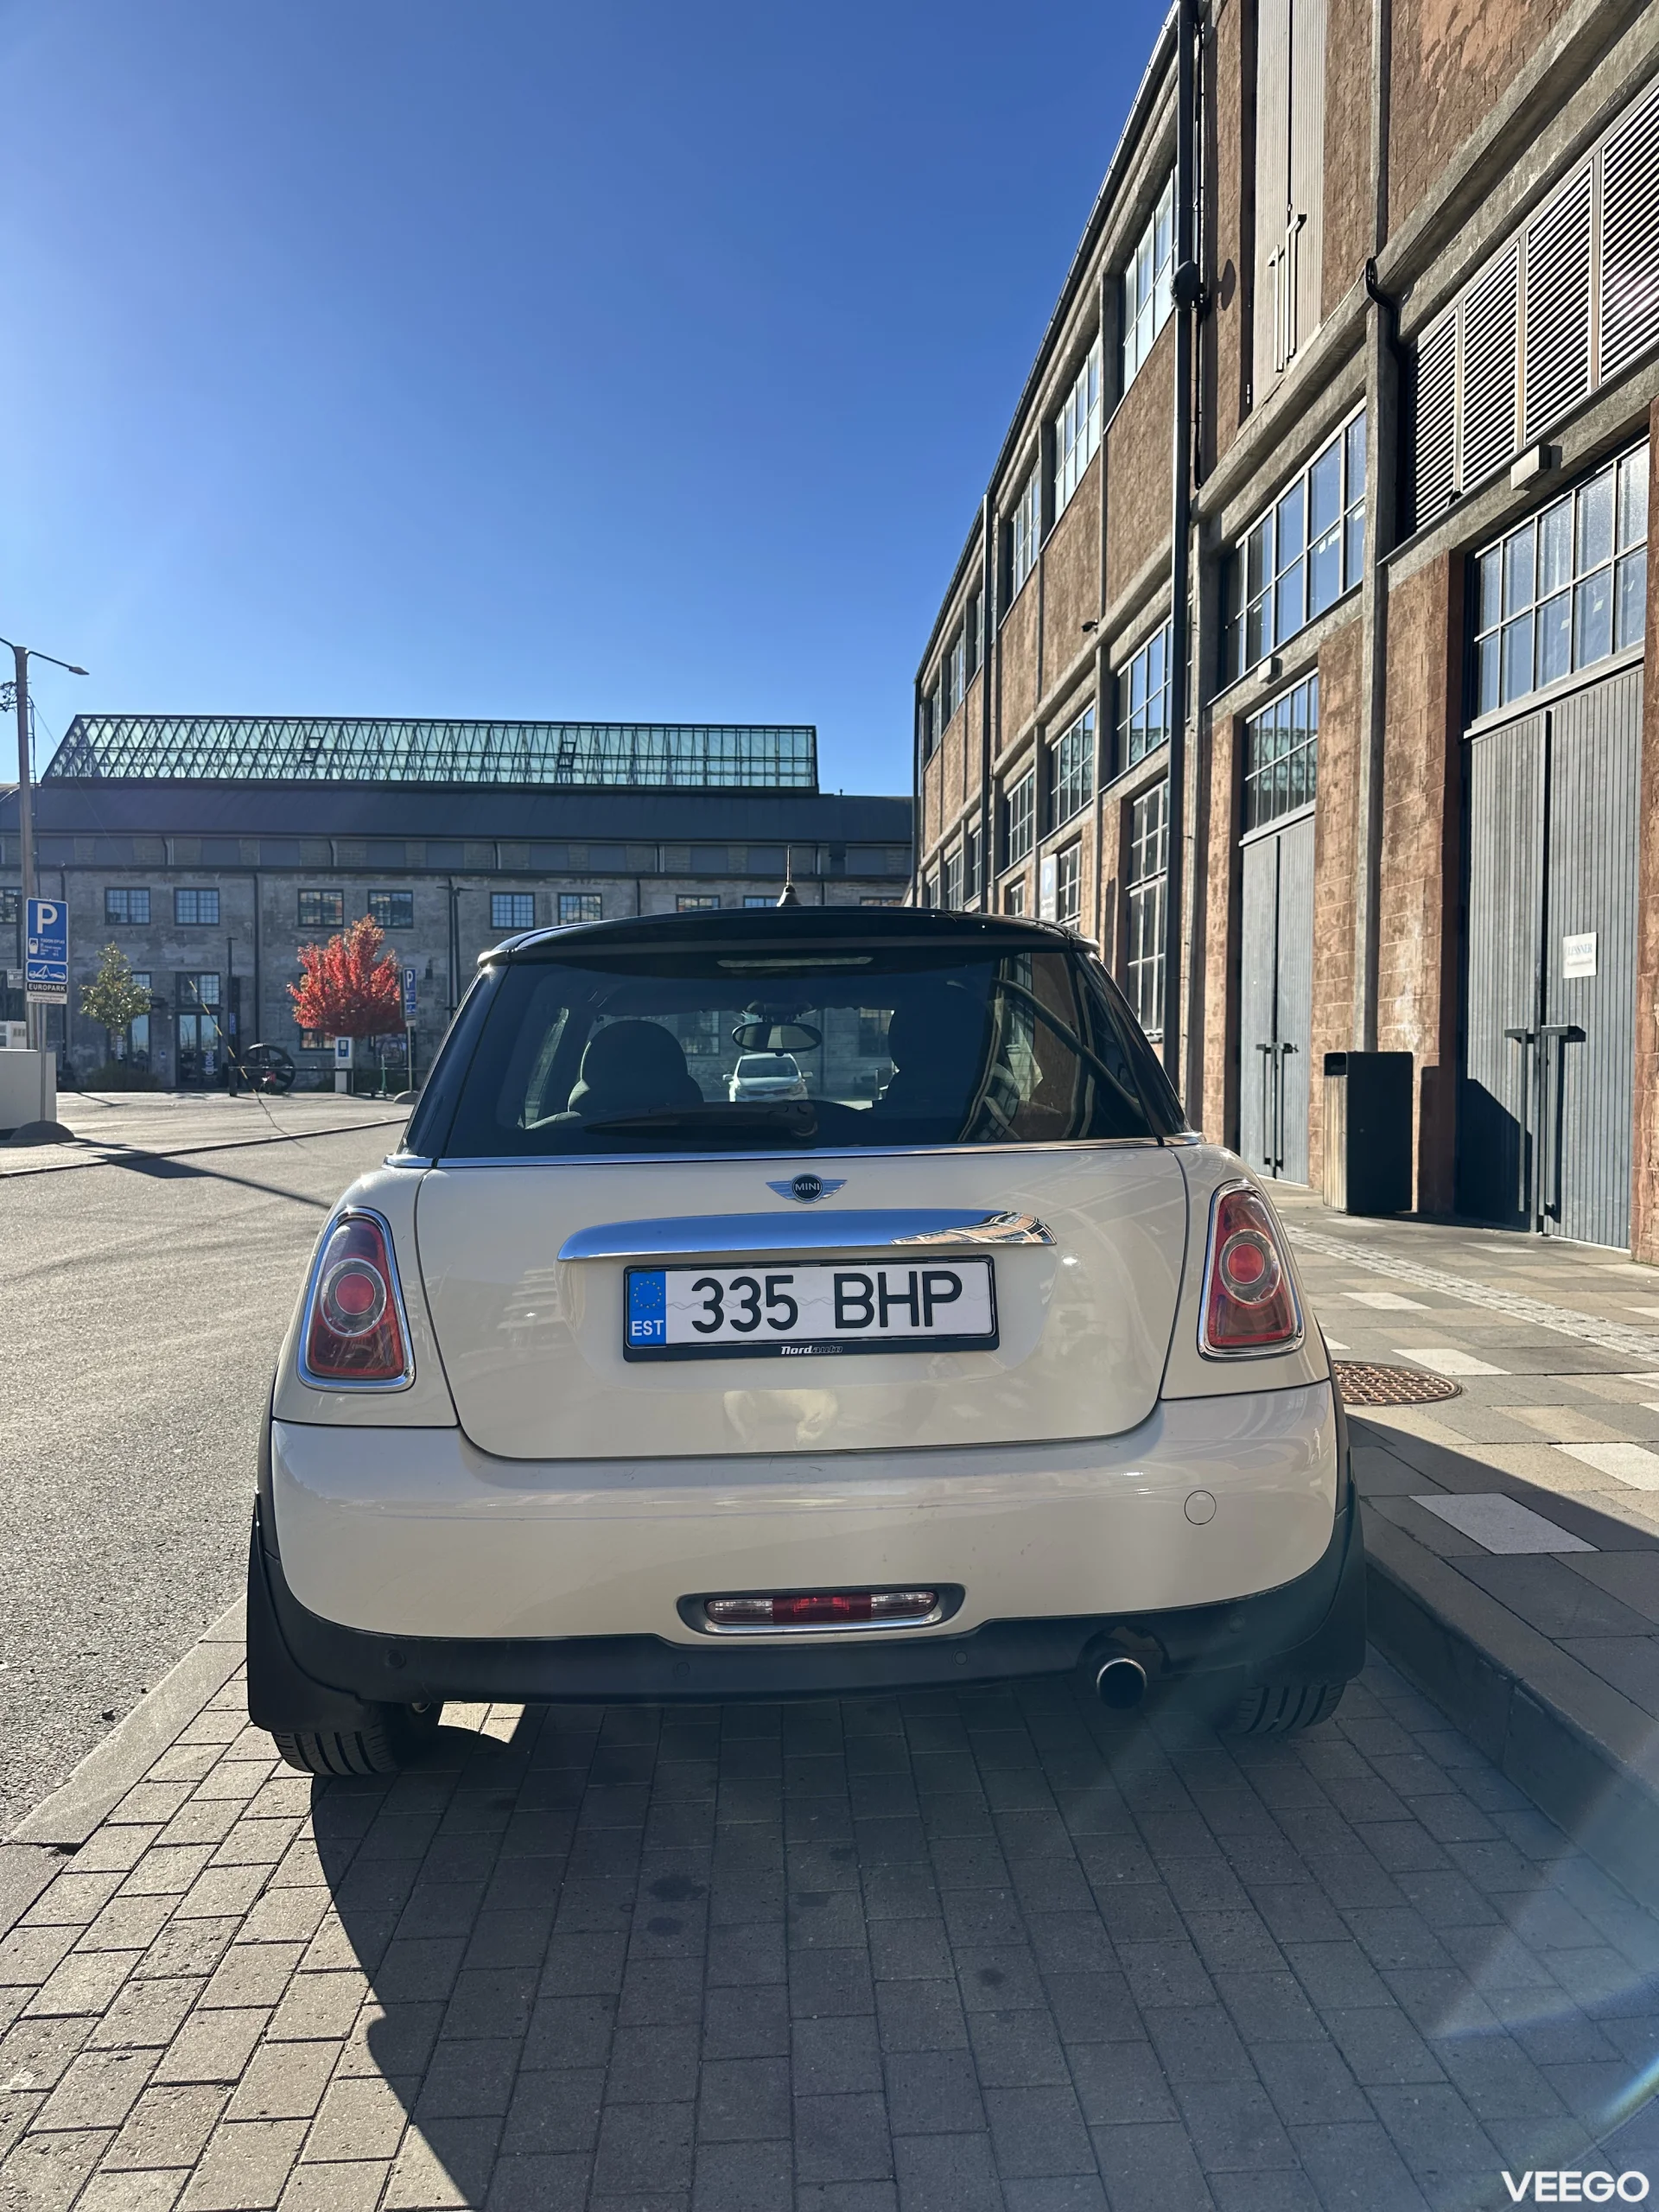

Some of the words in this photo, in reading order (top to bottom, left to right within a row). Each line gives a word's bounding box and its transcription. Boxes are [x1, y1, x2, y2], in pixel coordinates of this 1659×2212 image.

[37, 903, 58, 934] P
[29, 983, 66, 992] EUROPARK
[406, 970, 414, 988] P
[795, 1182, 820, 1192] MINI
[691, 1274, 798, 1334] 335
[833, 1270, 963, 1329] BHP
[632, 1319, 664, 1336] EST
